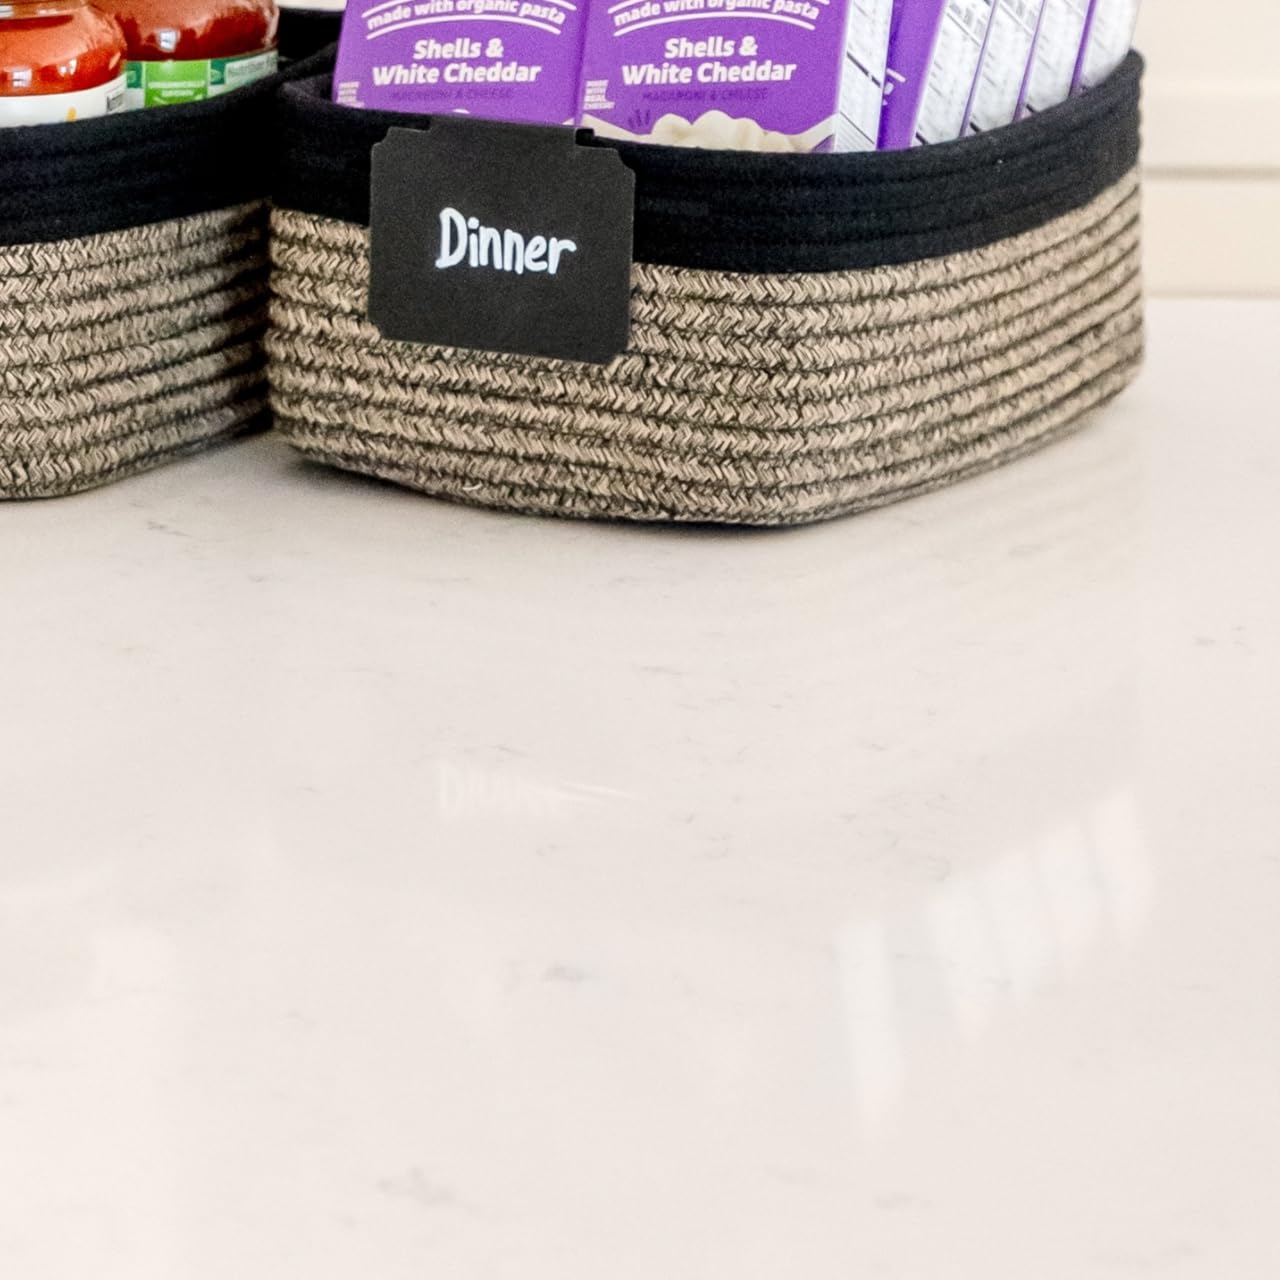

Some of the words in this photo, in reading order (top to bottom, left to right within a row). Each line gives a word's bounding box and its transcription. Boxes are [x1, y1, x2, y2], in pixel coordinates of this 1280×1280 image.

[367, 5, 411, 29] made
[519, 1, 566, 25] pasta
[614, 2, 661, 26] made
[413, 38, 482, 59] Shells
[485, 38, 504, 58] &
[664, 36, 735, 58] Shells
[739, 35, 758, 56] &
[372, 63, 440, 85] White
[443, 62, 542, 82] Cheddar
[622, 62, 692, 85] White
[697, 61, 797, 83] Cheddar
[435, 207, 577, 275] Dinner
